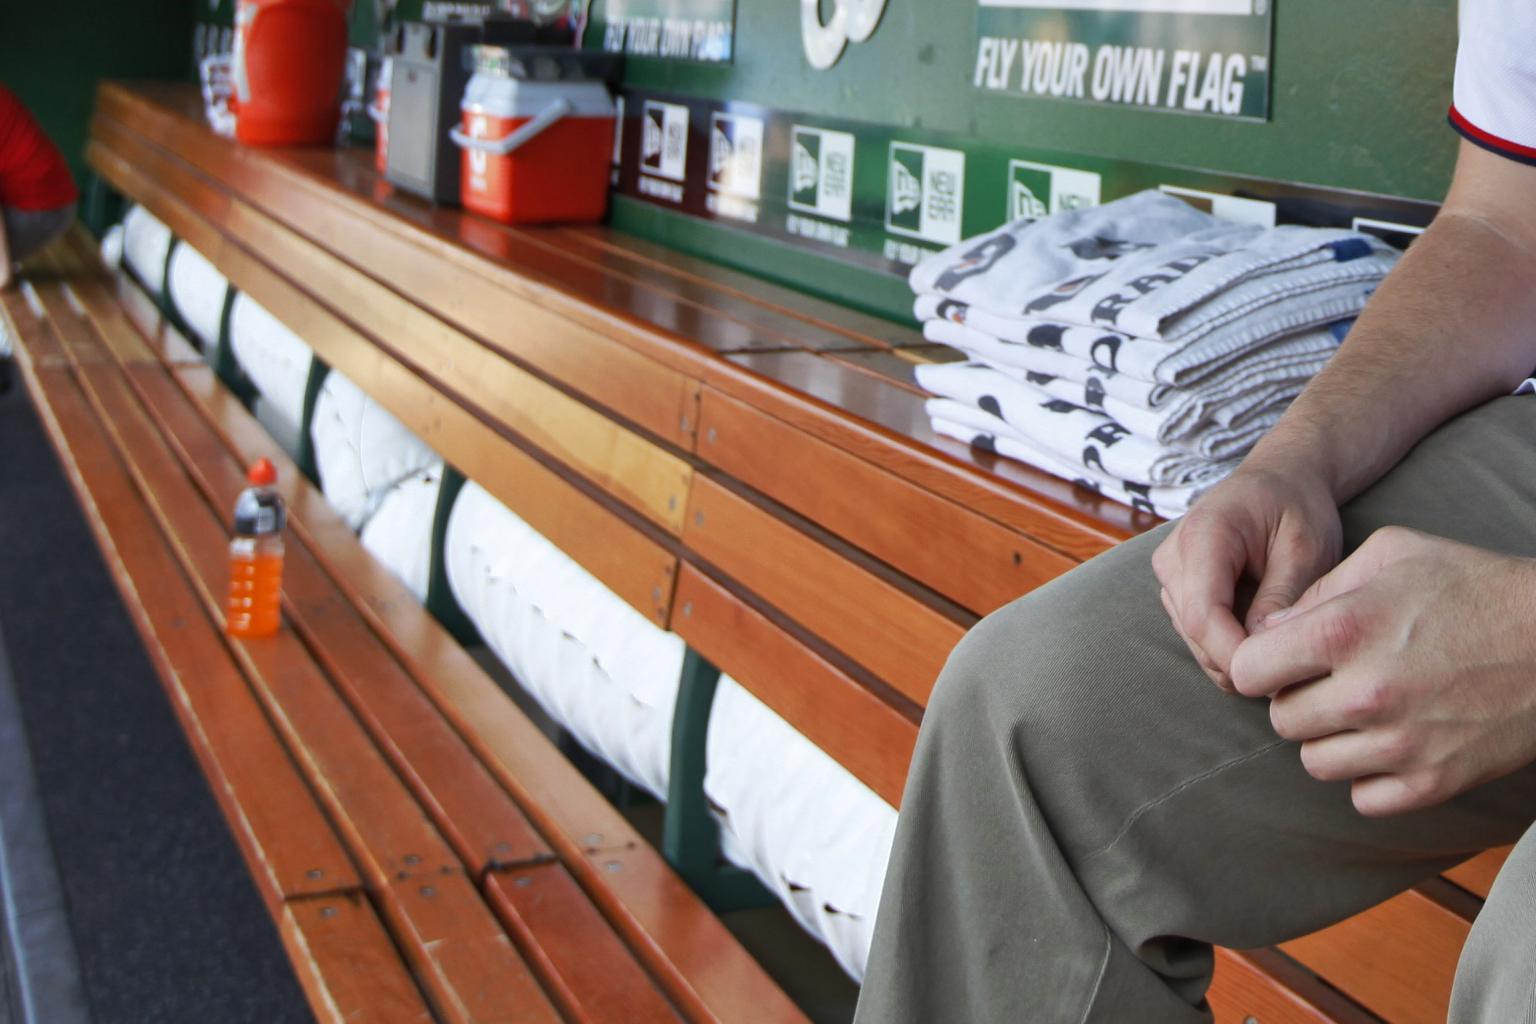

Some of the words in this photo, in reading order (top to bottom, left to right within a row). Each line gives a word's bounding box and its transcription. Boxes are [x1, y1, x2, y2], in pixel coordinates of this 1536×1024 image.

[973, 37, 1018, 90] FLY
[1021, 40, 1089, 99] YOUR
[1091, 44, 1165, 107] OWN
[1166, 50, 1247, 114] FLAG
